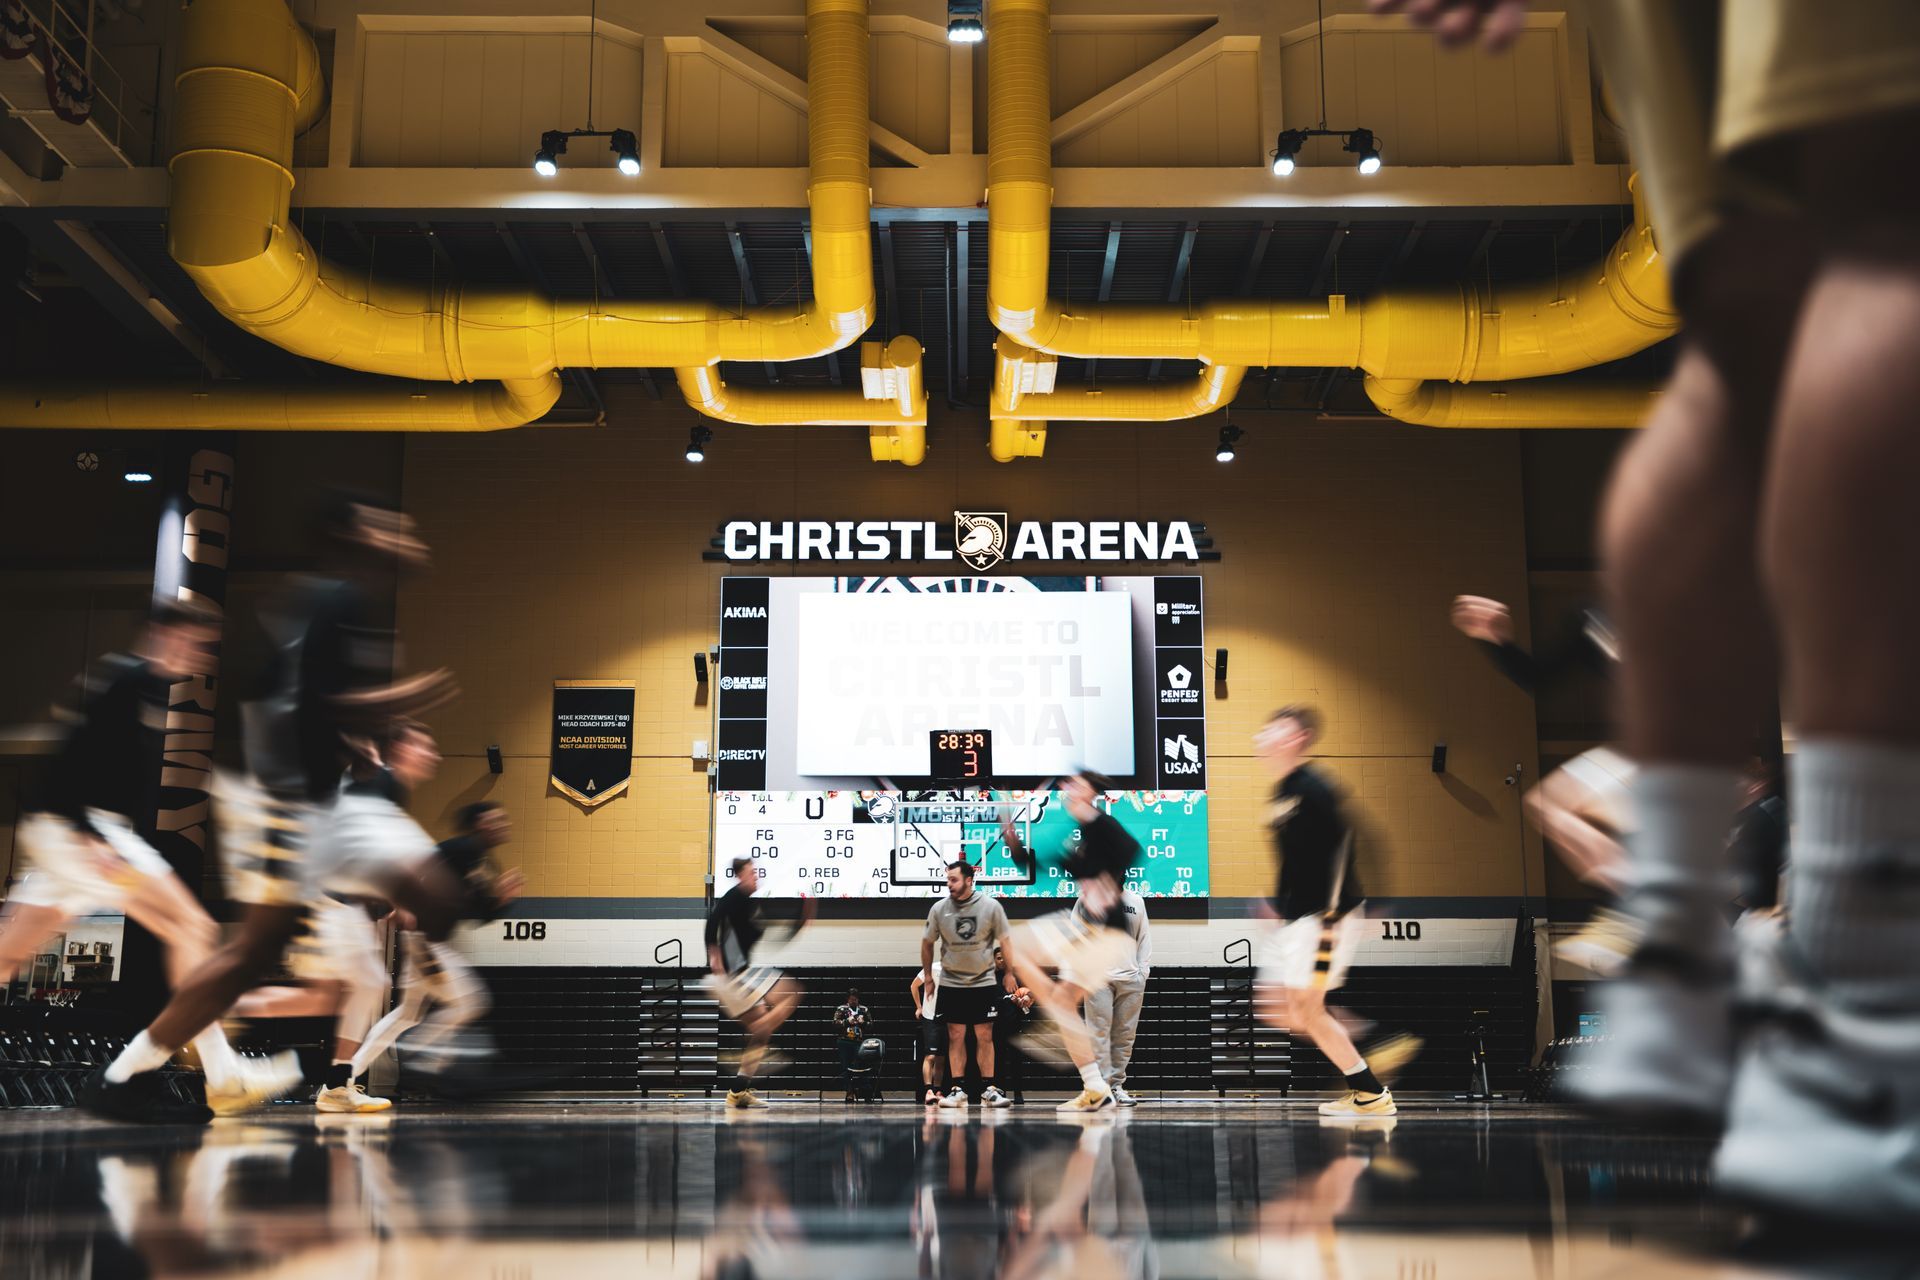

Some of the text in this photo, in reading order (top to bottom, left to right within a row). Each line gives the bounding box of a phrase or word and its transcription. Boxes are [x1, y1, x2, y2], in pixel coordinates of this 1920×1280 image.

[724, 521, 1199, 560] CHRISTL ARENA
[723, 606, 767, 618] AKIMA
[1171, 602, 1197, 611] Military
[849, 620, 1080, 645] WELCOME TO
[155, 448, 234, 852] GO RMY
[733, 676, 767, 684] BLACK RIFLE
[828, 654, 1102, 698] CHRISTL
[1161, 689, 1198, 698] PENFED
[853, 703, 1075, 747] ARENA
[938, 734, 984, 750] 28:39
[719, 750, 766, 761] DIRECTV
[963, 750, 978, 777] 3
[728, 804, 766, 815] 0 4
[1153, 804, 1193, 815] 4 0
[942, 814, 956, 823] 1ST
[756, 829, 774, 841] FG
[823, 829, 854, 841] 3 FG
[904, 829, 920, 841] FT
[1072, 829, 1082, 841] 3
[1152, 829, 1169, 841] FT
[751, 846, 778, 858] 0-0
[826, 846, 854, 858] 0-0
[899, 846, 926, 858] 0-0
[1147, 845, 1175, 858] 0-0
[799, 867, 840, 878] D. REB
[872, 867, 890, 878] AS
[1049, 867, 1062, 878] D.
[1176, 867, 1193, 878] TO
[815, 881, 824, 894] 0
[879, 881, 889, 893] 0
[1180, 881, 1190, 894] 0
[503, 921, 546, 940] 108
[1382, 921, 1421, 940] 110
